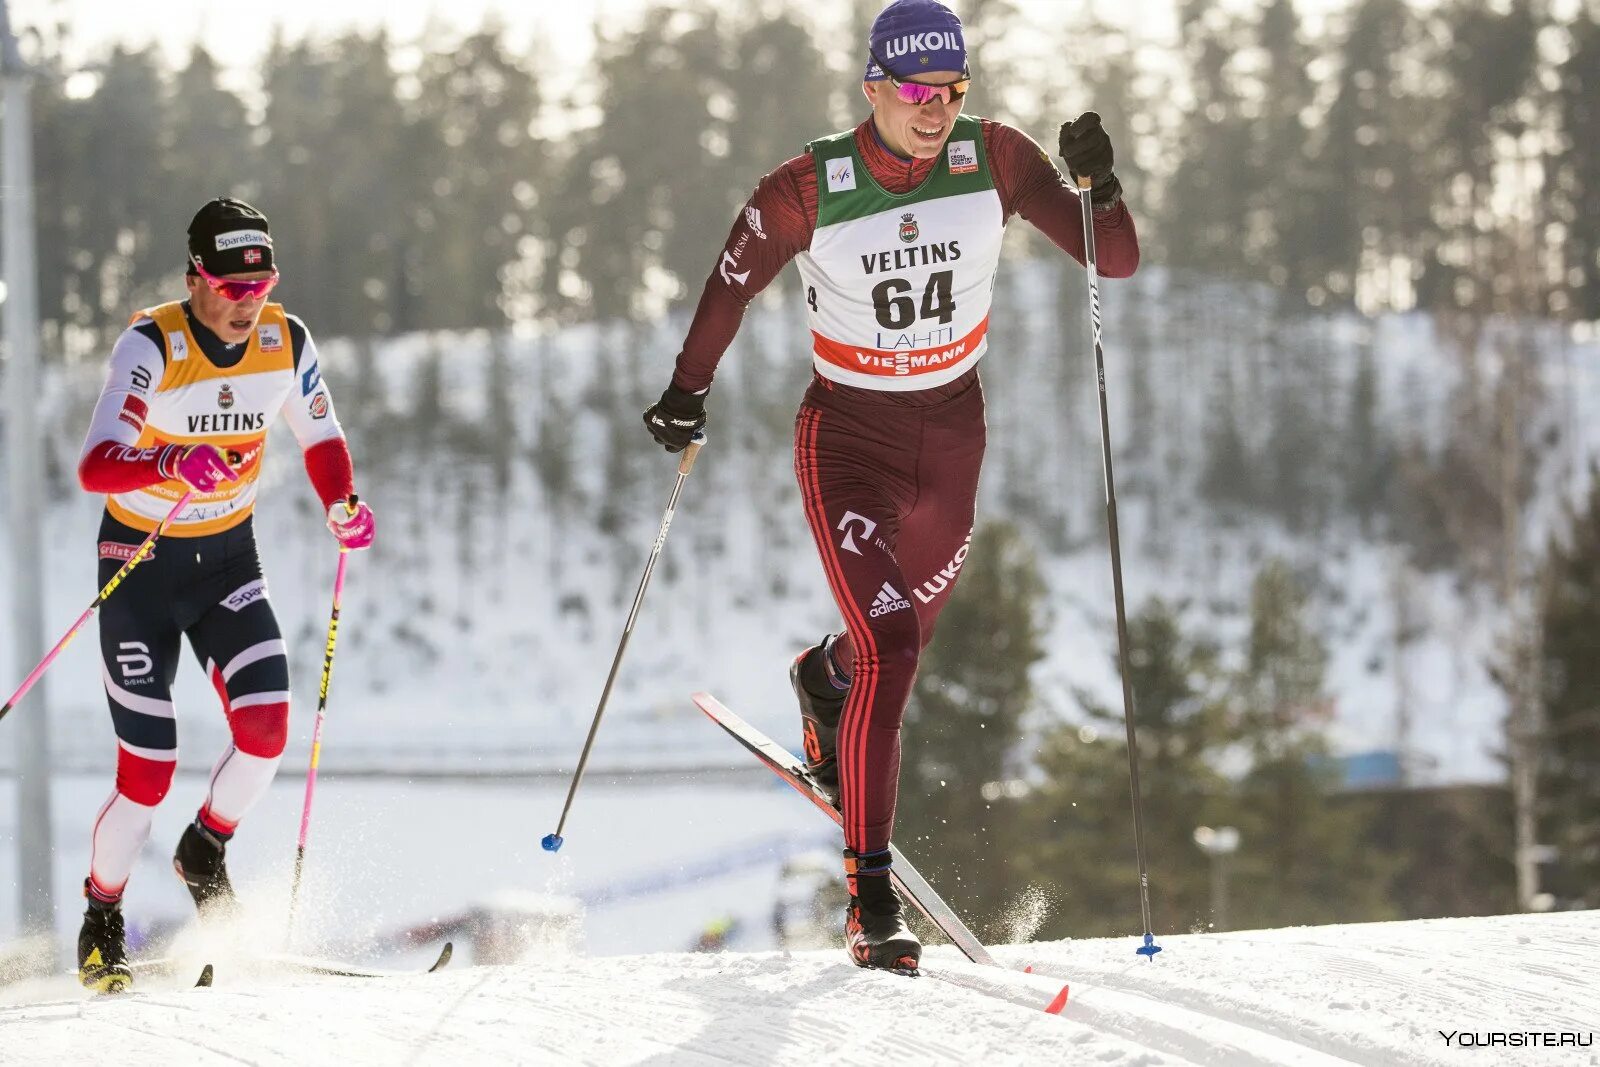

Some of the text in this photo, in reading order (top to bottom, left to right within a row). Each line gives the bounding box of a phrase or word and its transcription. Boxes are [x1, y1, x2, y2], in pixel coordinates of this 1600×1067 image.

[886, 31, 960, 59] LUKOIL
[733, 232, 750, 259] RUSAL
[861, 240, 961, 274] VELTINS
[871, 270, 957, 330] 64
[876, 327, 953, 350] LAHTI
[856, 342, 966, 375] VIESSMANN
[187, 412, 265, 433] VELTINS
[913, 527, 974, 604] LUKO
[869, 599, 911, 618] adidas
